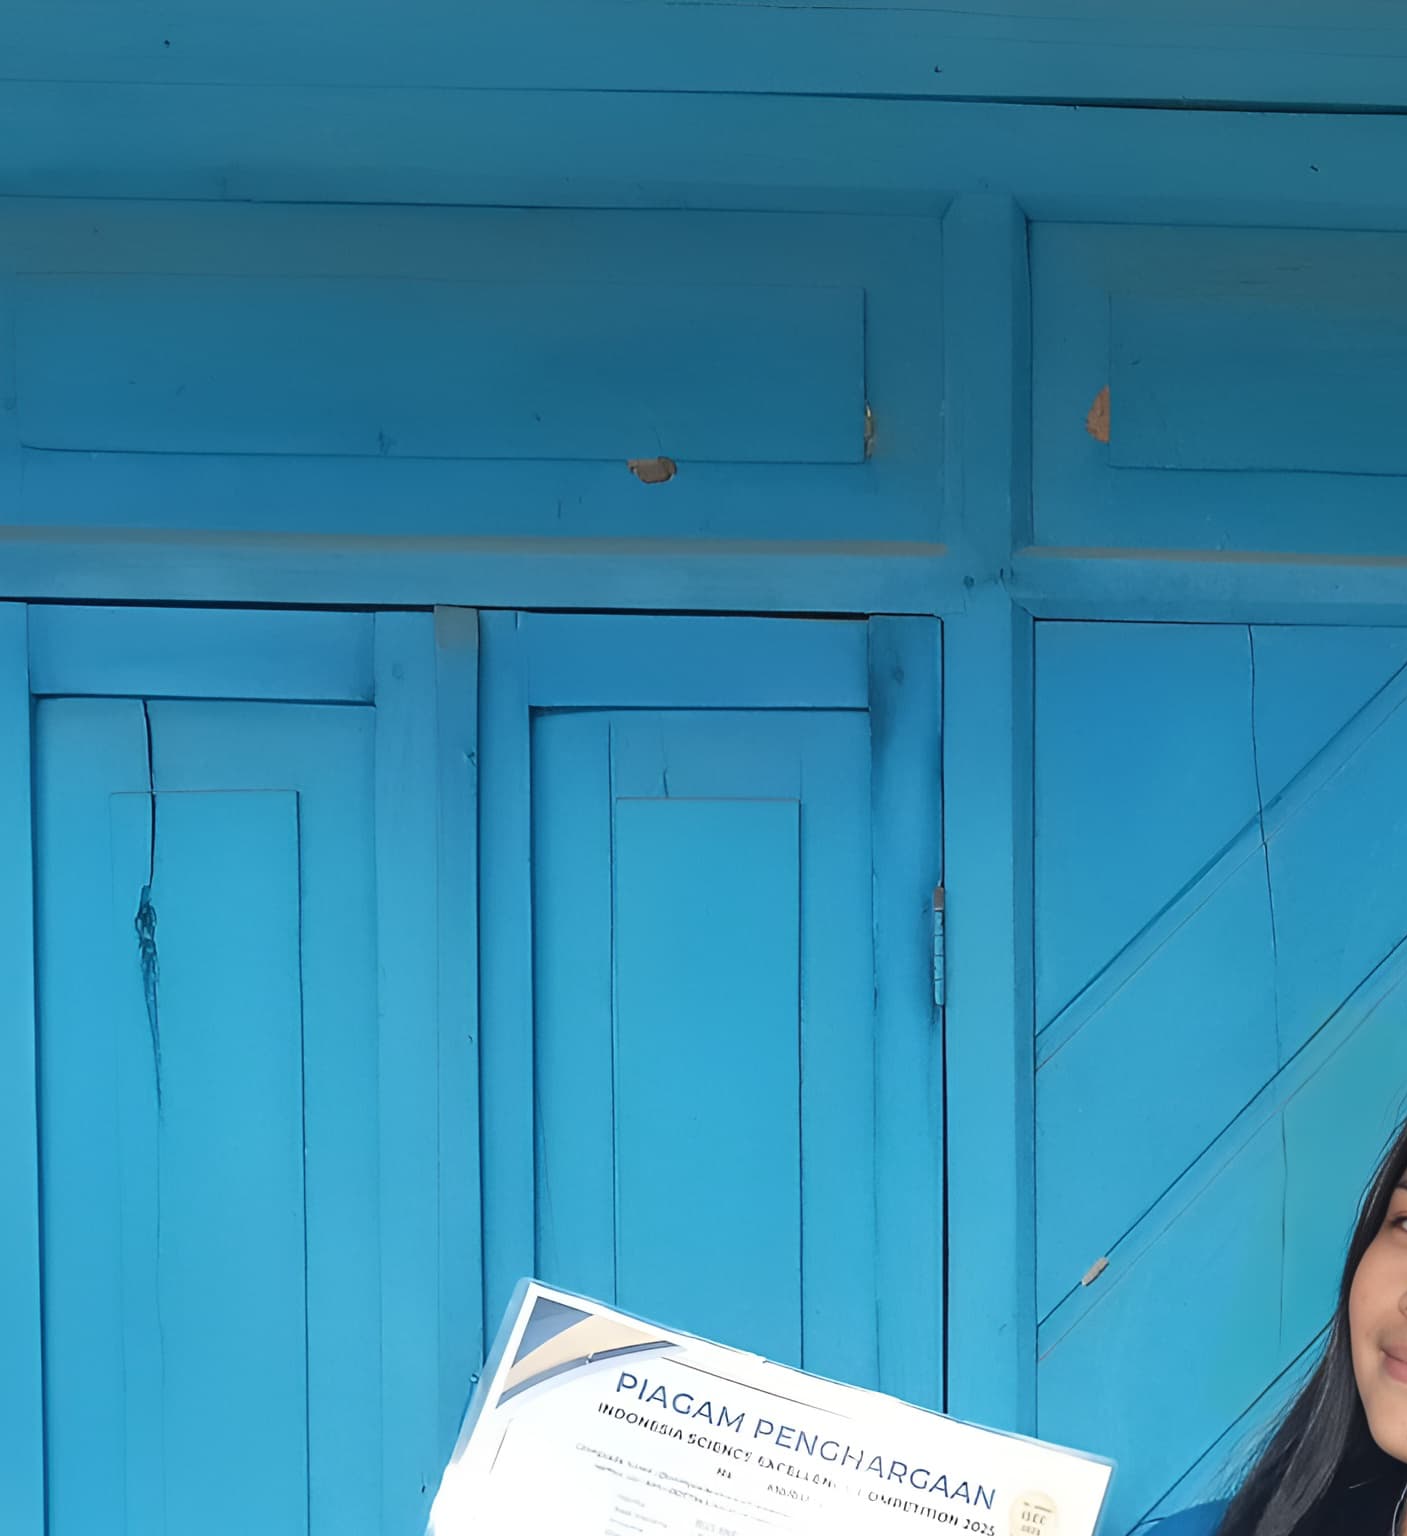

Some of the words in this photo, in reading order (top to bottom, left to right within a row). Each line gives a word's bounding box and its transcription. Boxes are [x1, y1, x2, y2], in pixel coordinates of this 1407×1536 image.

[598, 1402, 683, 1440] INDONESIA
[757, 1455, 848, 1493] EXCELLEN
[857, 1488, 959, 1527] OMPETITION
[963, 1518, 996, 1536] 2025
[616, 1371, 746, 1433] PIAGAM
[753, 1418, 996, 1510] PENGHARGAAN
